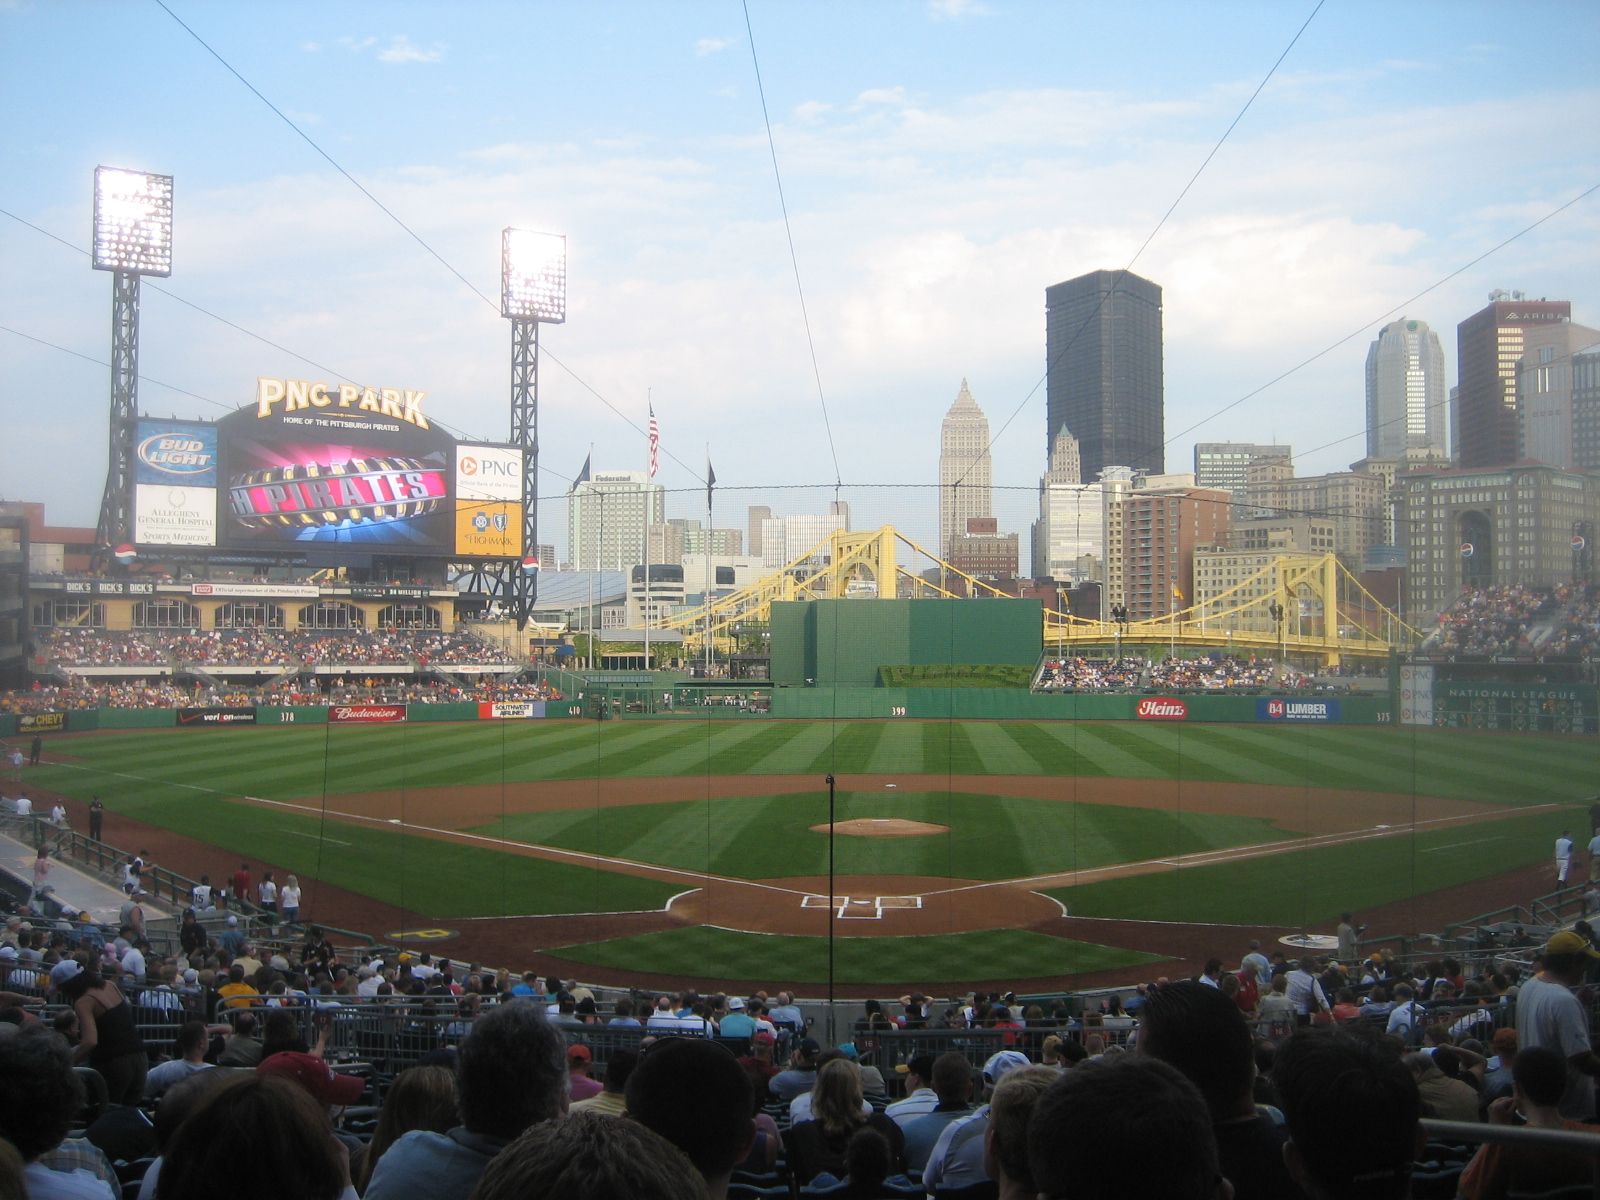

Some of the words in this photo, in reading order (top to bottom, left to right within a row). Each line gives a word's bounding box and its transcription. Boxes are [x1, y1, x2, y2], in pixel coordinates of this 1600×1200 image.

[257, 376, 332, 419] PNC
[337, 383, 429, 430] PARK
[283, 416, 303, 425] HOME
[316, 418, 329, 427] THE
[330, 420, 372, 430] PITTSBURGH
[373, 423, 400, 432] PIRATES
[158, 439, 204, 452] BUD
[148, 451, 212, 466] LIGHT
[481, 459, 519, 477] PNC
[595, 474, 631, 482] Federated
[262, 471, 430, 514] PIRATES
[151, 508, 201, 518] ALLEGHENY
[138, 516, 177, 525] GENERAL
[178, 516, 214, 527] HOSPITAL
[143, 531, 170, 541] SPORTS
[172, 532, 209, 542] MEDICINE
[465, 534, 512, 546] HIGHMARK
[66, 582, 91, 592] DICK'S
[99, 583, 123, 592] DICK'S
[129, 583, 153, 592] DICK'S
[1450, 689, 1516, 699] NATIONAL
[1522, 690, 1576, 700] LEAGUE
[335, 707, 397, 719] Budweiser
[568, 706, 580, 715] 410
[892, 706, 906, 716] 399
[1138, 701, 1185, 716] Heinz
[1269, 703, 1283, 714] 84
[1286, 703, 1327, 714] LUMBER
[36, 713, 65, 725] CHEVY
[203, 712, 234, 722] verizon
[280, 711, 295, 722] 378
[1377, 712, 1390, 722] 375
[194, 893, 205, 904] 15
